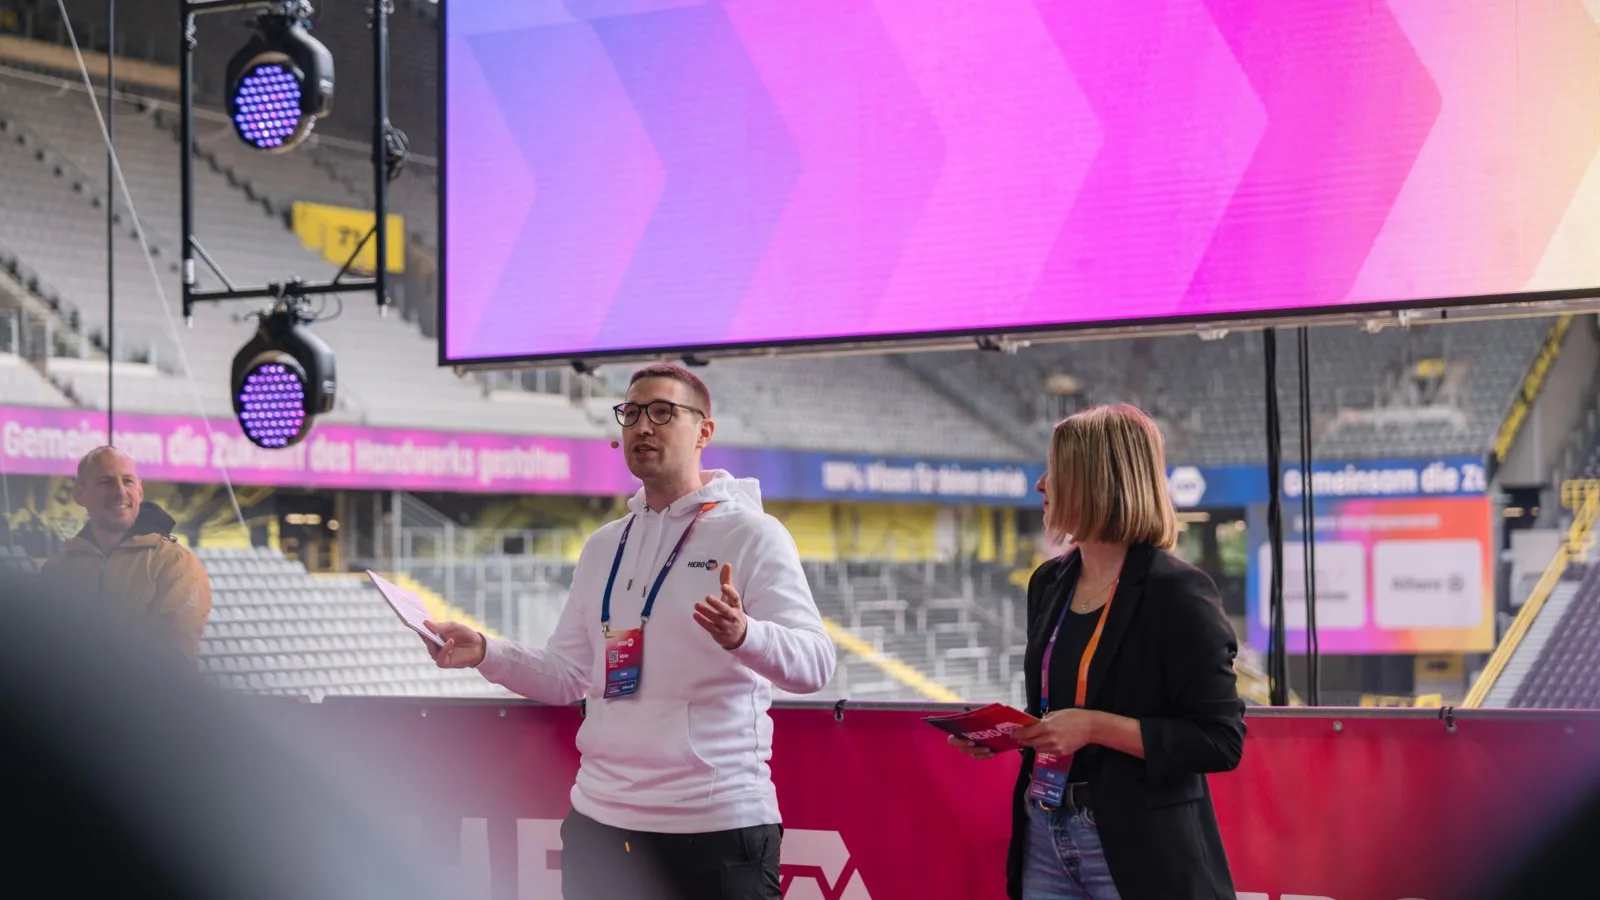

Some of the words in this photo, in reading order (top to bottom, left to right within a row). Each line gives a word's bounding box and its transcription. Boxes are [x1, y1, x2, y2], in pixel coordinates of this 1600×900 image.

[167, 424, 208, 468] die
[1420, 461, 1460, 493] die
[961, 729, 1002, 741] HERO
